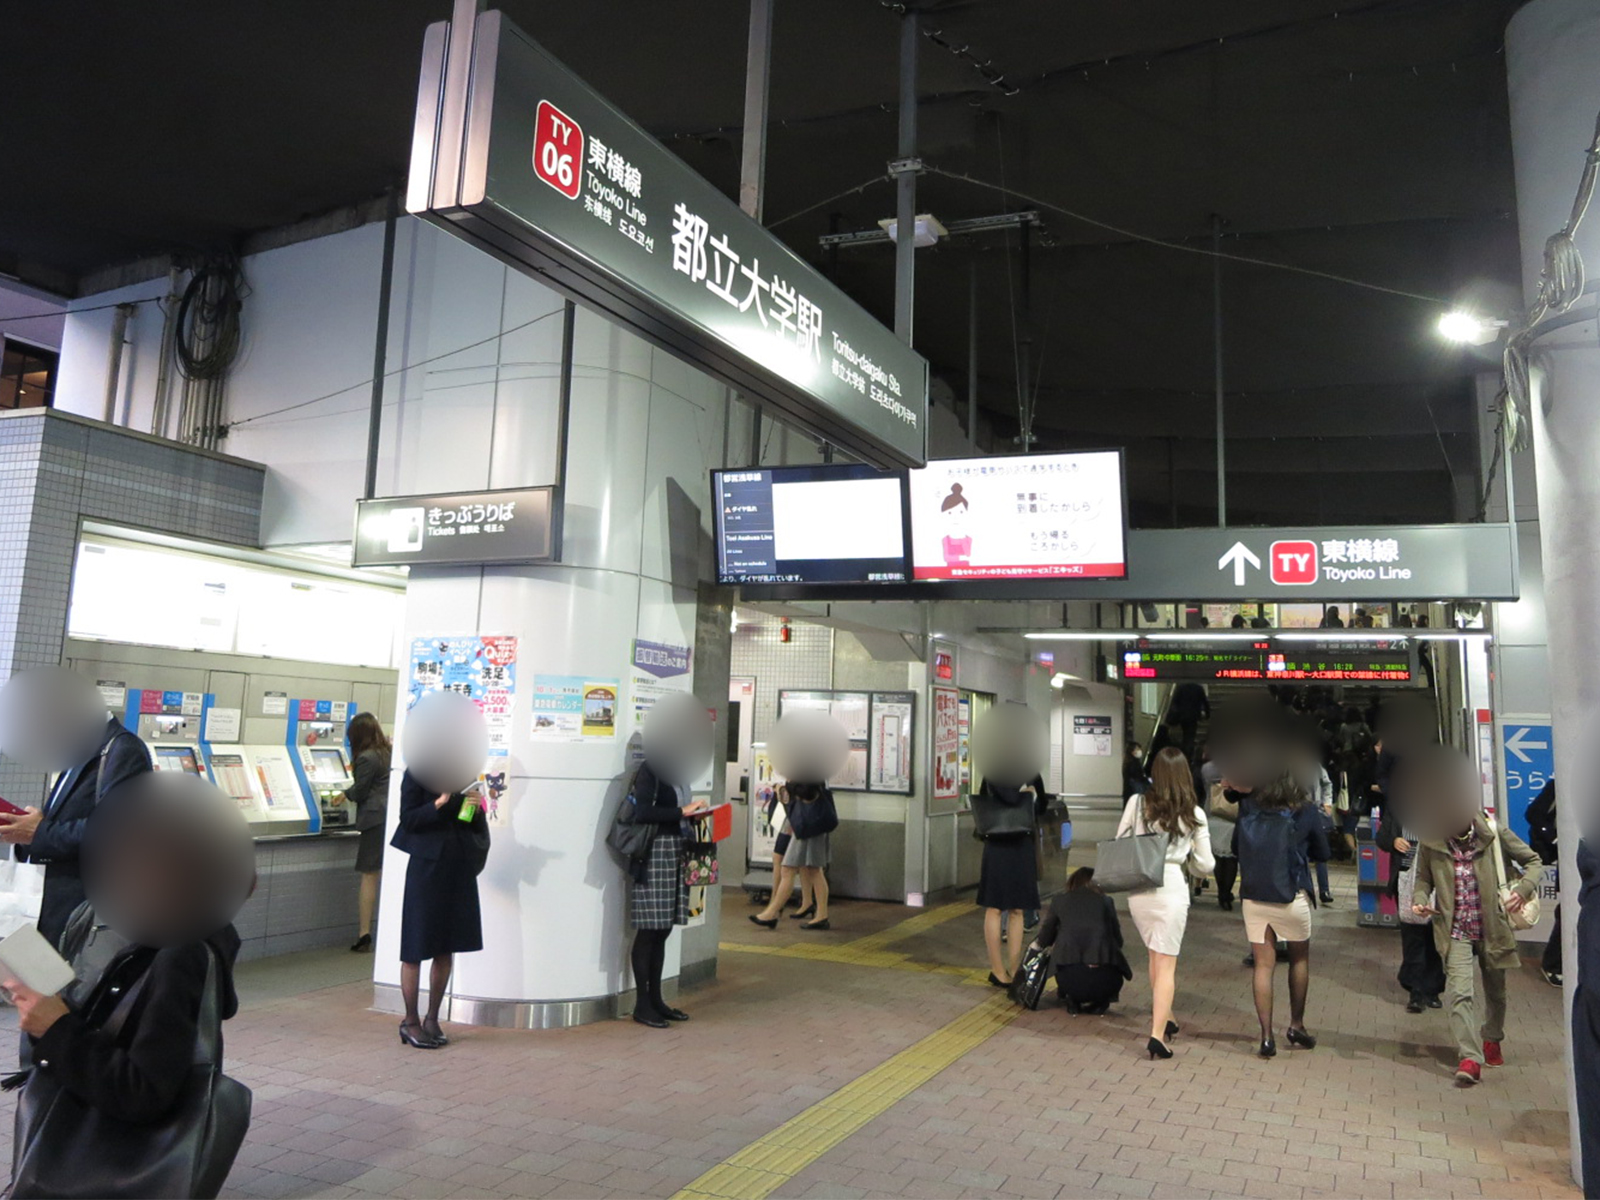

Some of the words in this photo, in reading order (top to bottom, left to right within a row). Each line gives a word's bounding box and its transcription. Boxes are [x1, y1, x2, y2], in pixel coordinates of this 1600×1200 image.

[550, 114, 573, 146] TY
[542, 141, 573, 187] 06
[587, 135, 642, 198] 東横線
[625, 198, 647, 226] Line
[618, 218, 654, 254] 도요코선
[671, 202, 822, 364] 都立大学駅
[427, 502, 515, 525] きっぷうりば
[428, 526, 456, 537] Tickets
[1278, 553, 1310, 572] TY
[1321, 538, 1399, 563] 東横線
[1379, 566, 1411, 580] Line
[482, 666, 504, 680] 洗足
[1507, 770, 1555, 790] うら
